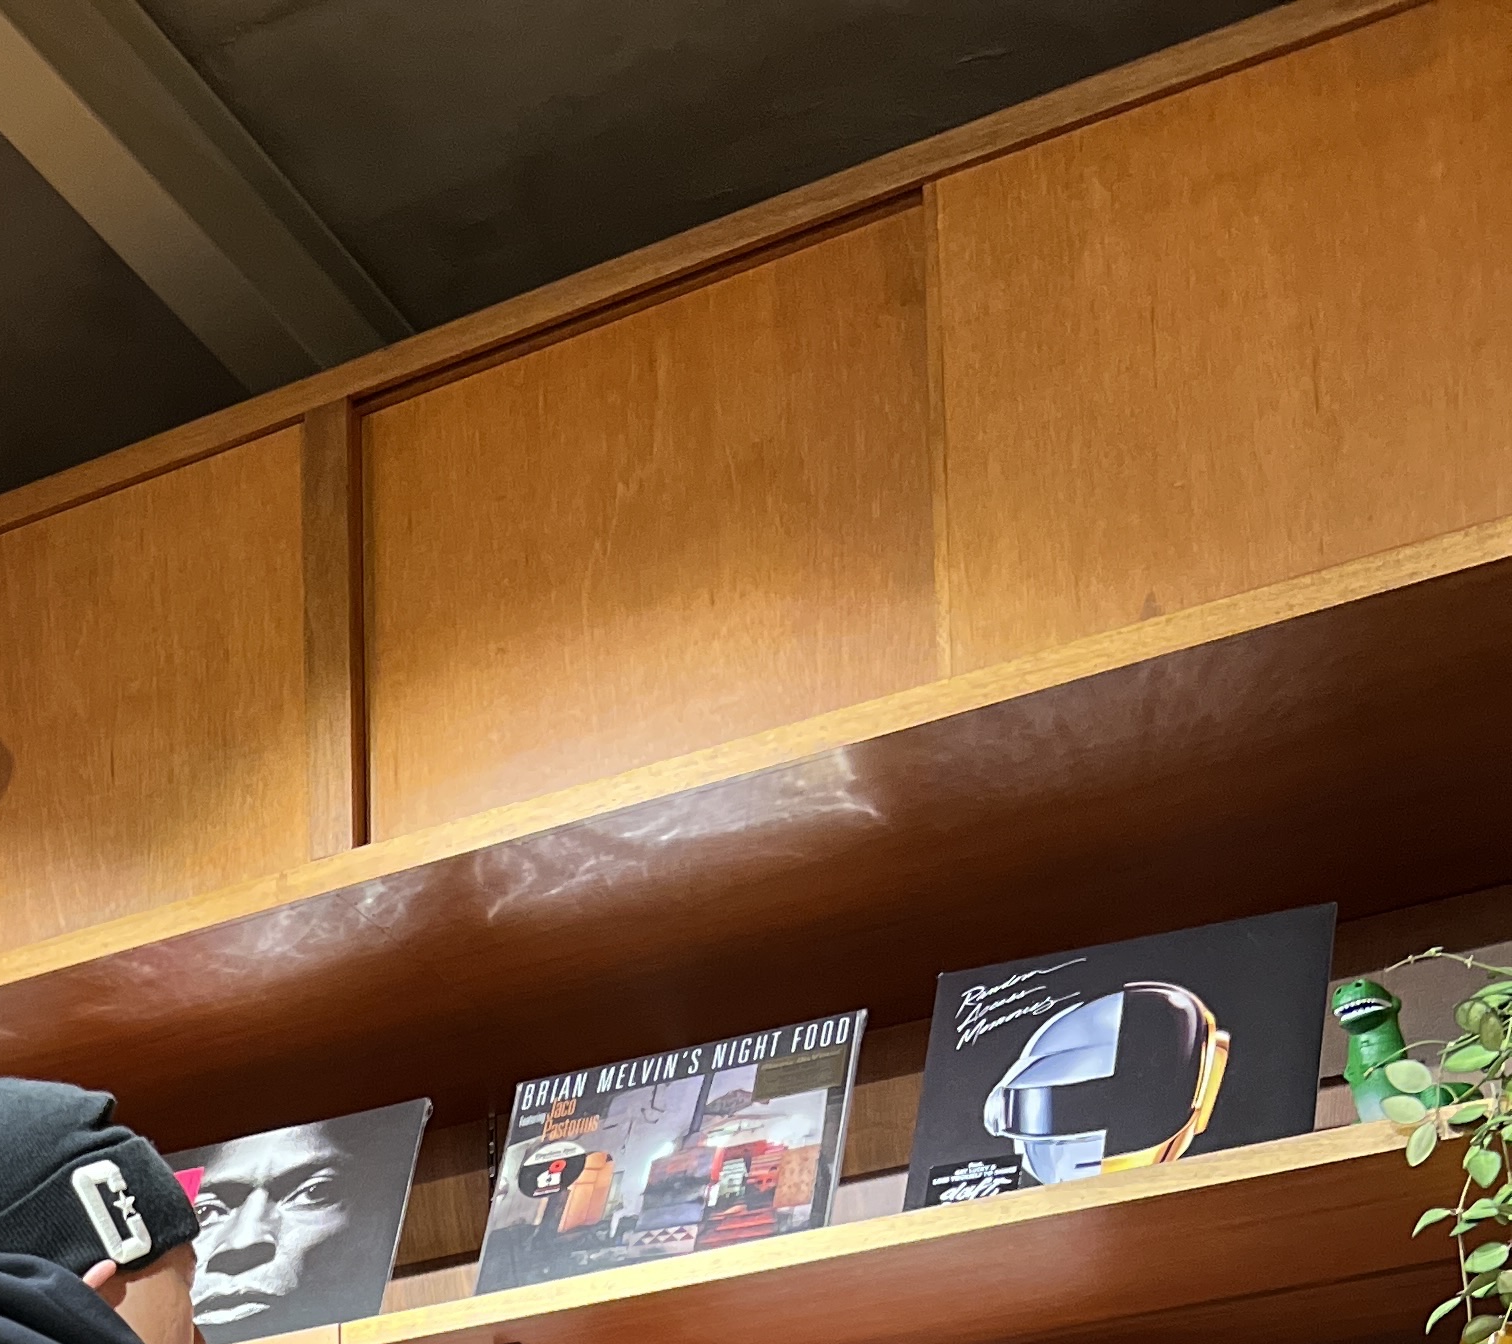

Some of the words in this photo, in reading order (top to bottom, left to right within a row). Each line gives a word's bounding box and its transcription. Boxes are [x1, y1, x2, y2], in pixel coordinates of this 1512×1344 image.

[955, 958, 1086, 1019] Random
[957, 986, 1046, 1033] Access
[956, 991, 1080, 1050] Memories
[521, 1072, 588, 1111] BRIAN
[596, 1048, 701, 1094] MELVIN'S
[711, 1031, 782, 1069] NIGHT
[790, 1016, 851, 1054] FOOD
